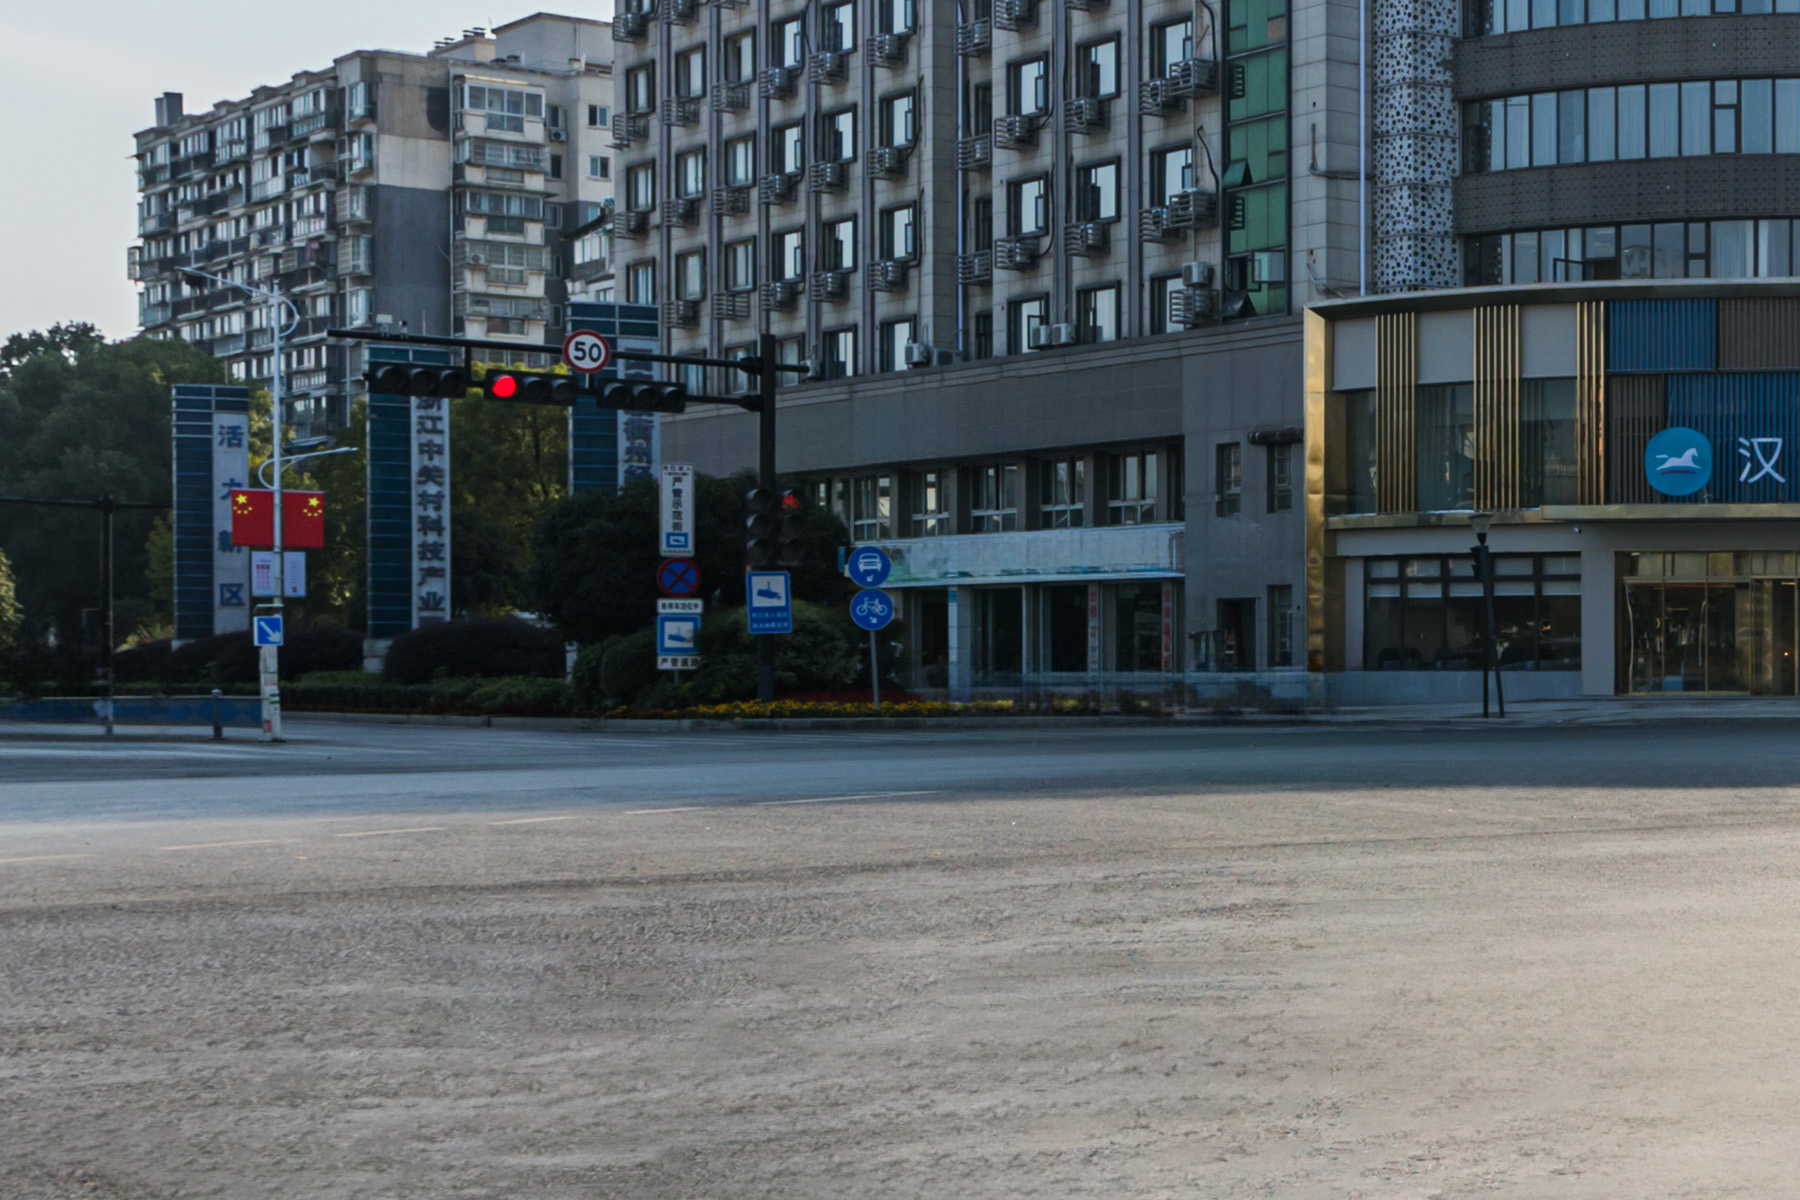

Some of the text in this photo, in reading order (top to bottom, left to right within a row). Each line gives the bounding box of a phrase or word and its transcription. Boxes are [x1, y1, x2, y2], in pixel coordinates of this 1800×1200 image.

[574, 341, 602, 362] 50
[672, 477, 683, 532] 严管示范街
